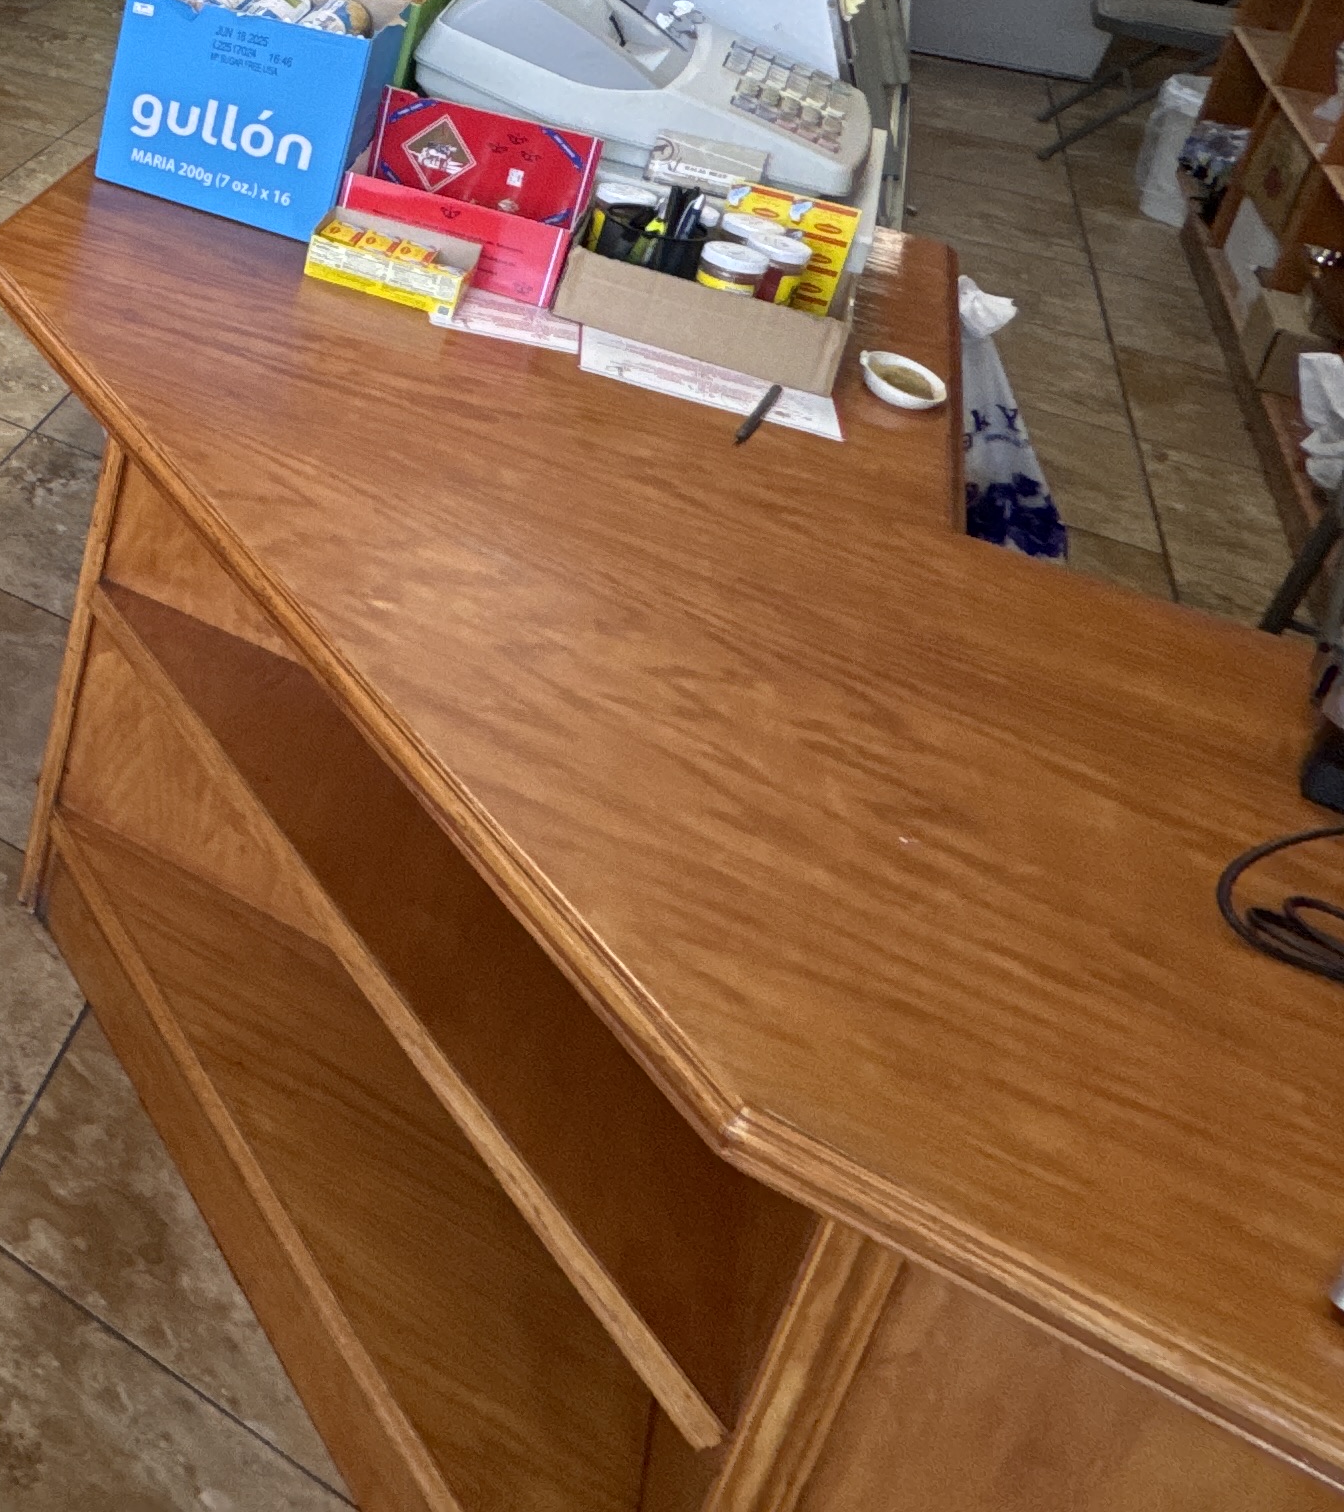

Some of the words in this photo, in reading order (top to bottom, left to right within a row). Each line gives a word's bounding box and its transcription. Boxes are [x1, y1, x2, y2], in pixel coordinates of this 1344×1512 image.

[215, 25, 234, 38] JUN
[247, 32, 270, 48] 2025
[129, 92, 313, 172] gullón
[130, 147, 175, 175] MARIA
[178, 162, 213, 188] 200g
[215, 170, 230, 190] (7
[231, 178, 259, 202] oz.)
[259, 188, 270, 201] x
[273, 190, 291, 208] 16
